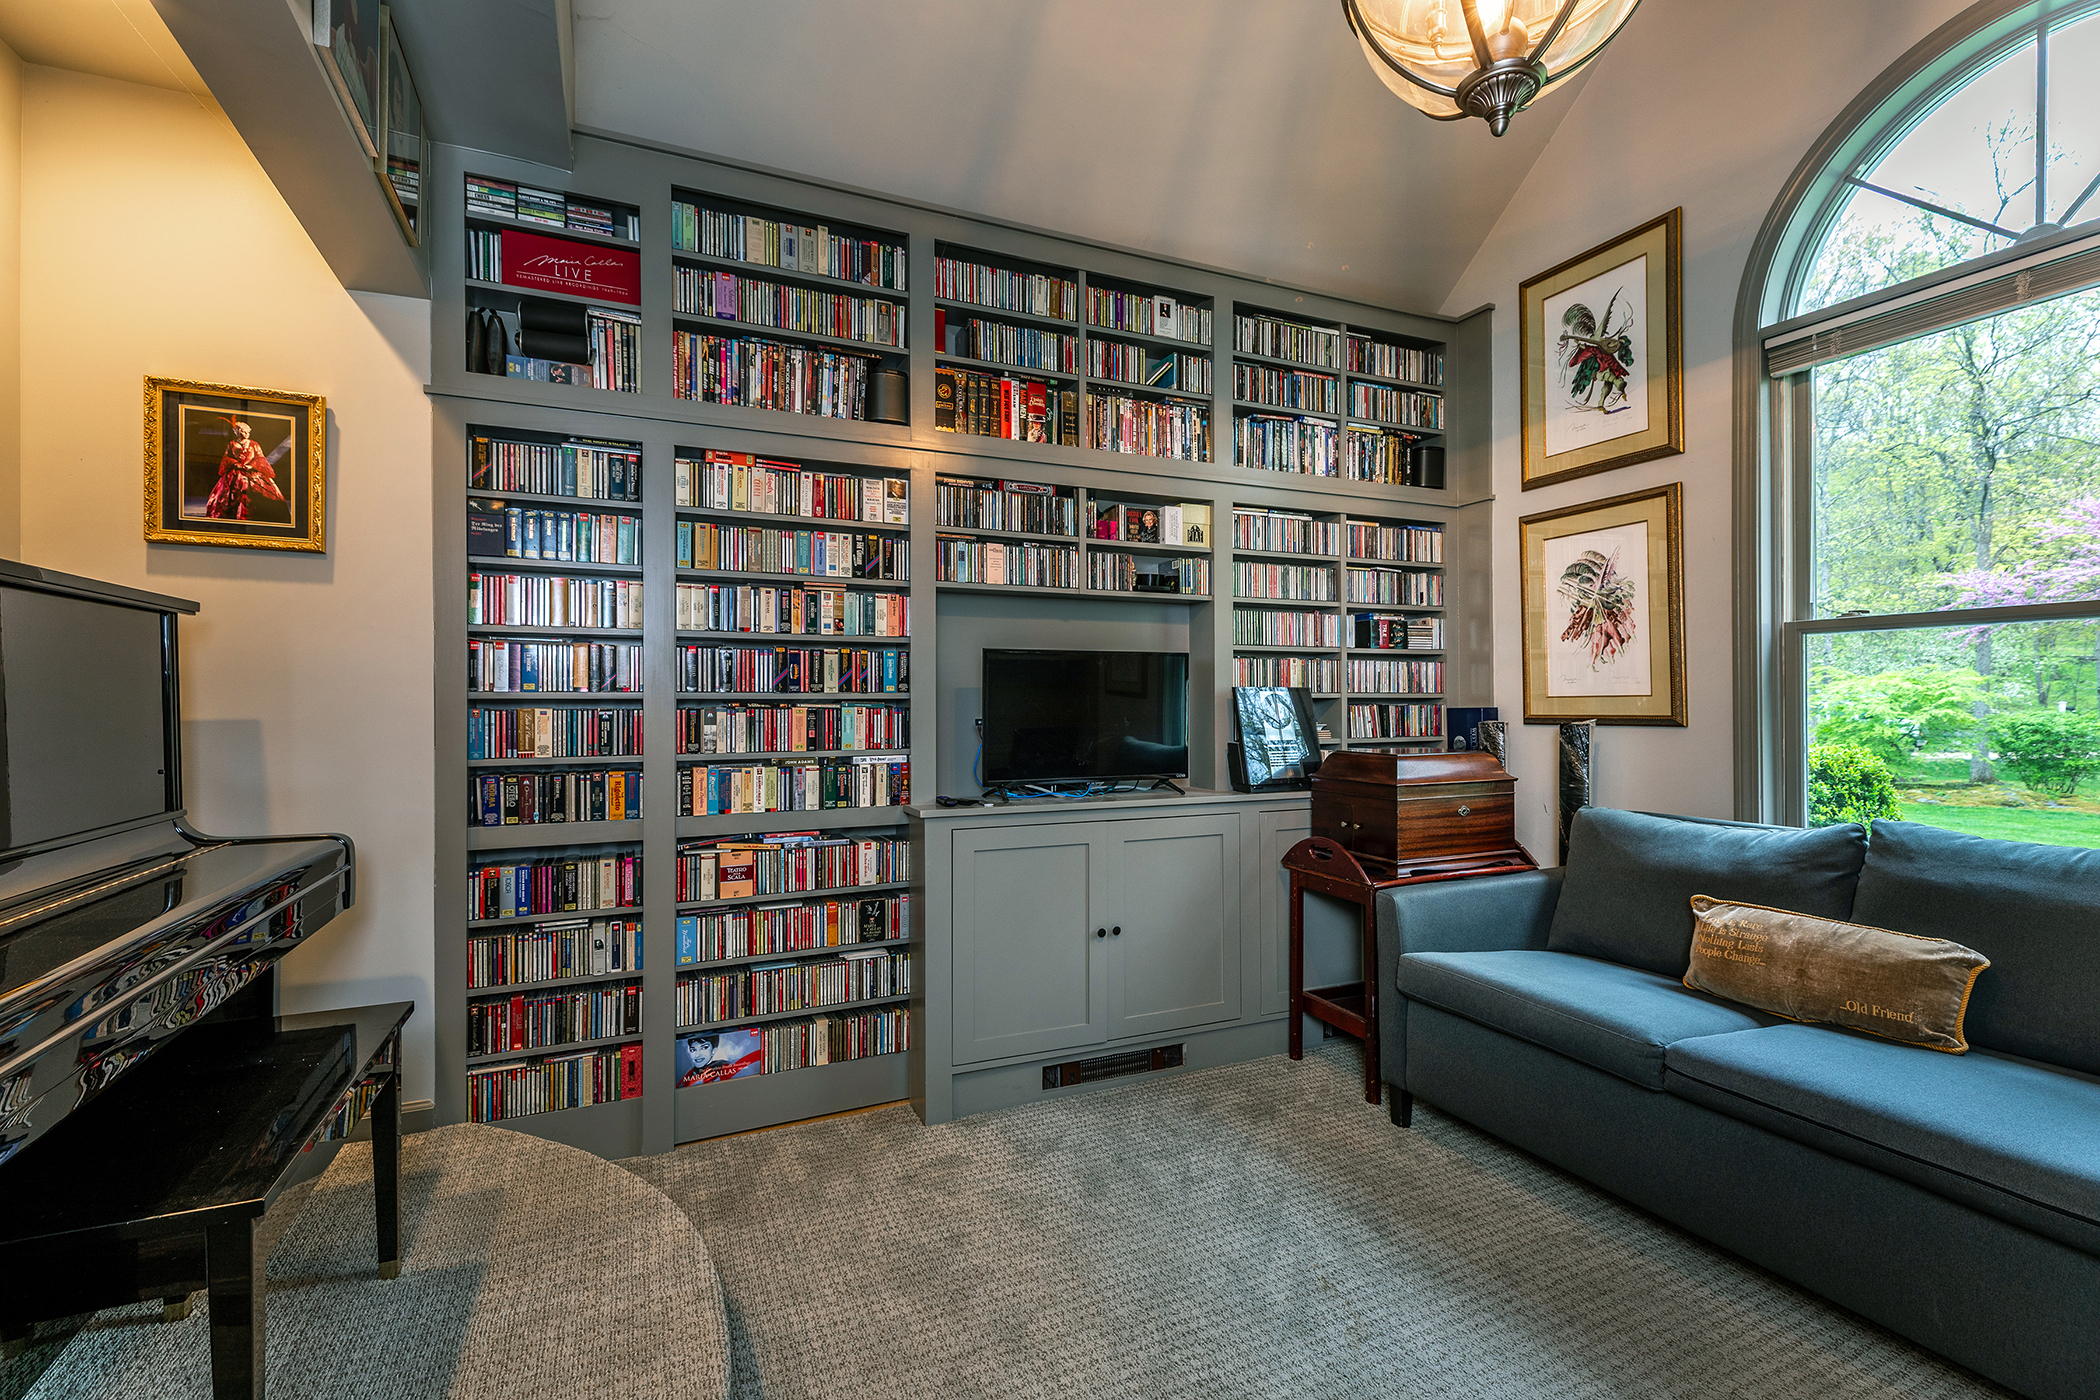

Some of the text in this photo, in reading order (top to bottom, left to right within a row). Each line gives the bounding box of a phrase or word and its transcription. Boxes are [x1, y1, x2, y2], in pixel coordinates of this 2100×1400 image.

[555, 265, 591, 281] LIVE
[516, 274, 549, 283] REMASTERED
[566, 282, 599, 291] RECORDINGS
[1187, 530, 1204, 543] PIAF
[1700, 922, 1716, 933] Life
[1729, 928, 1768, 942] Strange
[1728, 918, 1736, 926] is
[1740, 919, 1763, 930] Rare
[1695, 944, 1722, 958] People
[1698, 933, 1763, 953] Nothing Lasts
[1872, 1004, 1913, 1022] Friend
[683, 1068, 737, 1082] MARIA CALLAS
